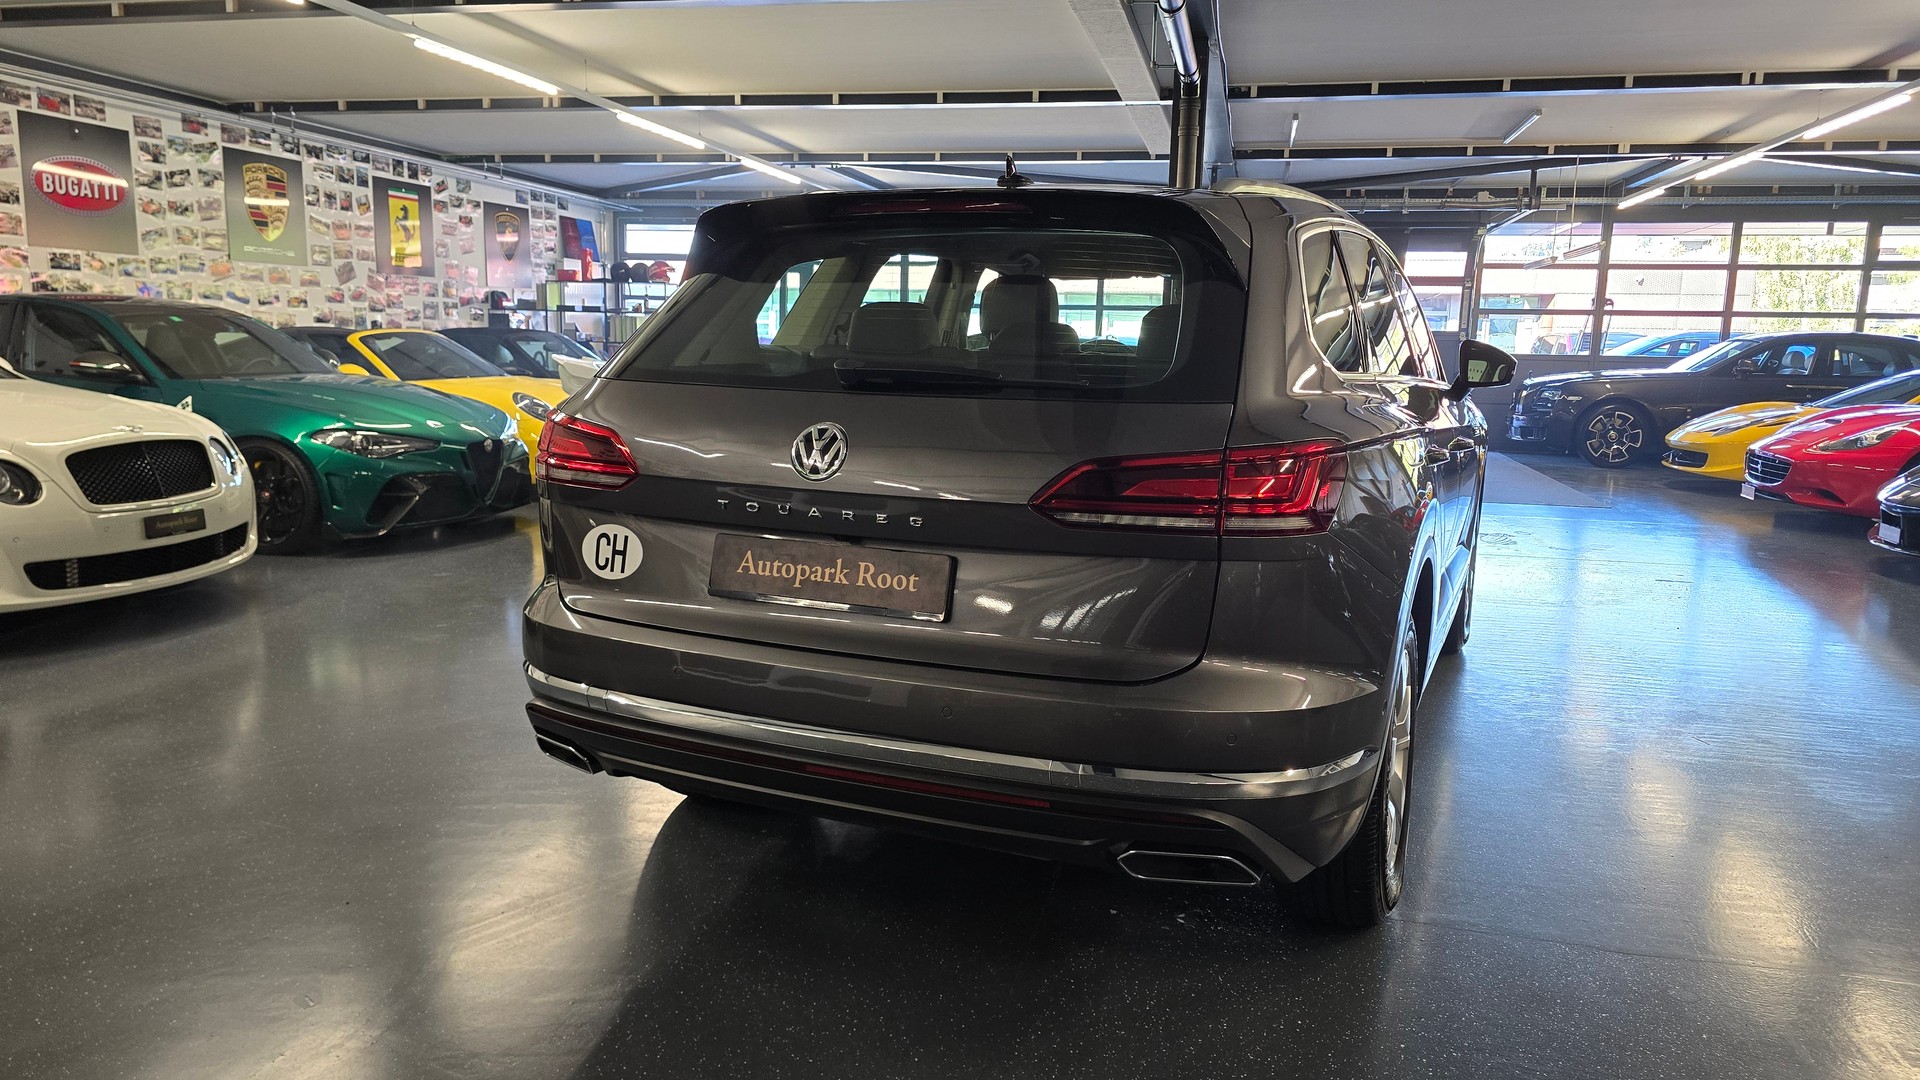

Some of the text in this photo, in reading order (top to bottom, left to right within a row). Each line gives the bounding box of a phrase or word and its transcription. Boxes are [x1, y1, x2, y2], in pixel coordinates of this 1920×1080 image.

[42, 173, 118, 202] BUGATTI
[717, 499, 924, 527] TOUAREG
[595, 532, 629, 574] CH
[736, 550, 919, 592] Autopark Root
